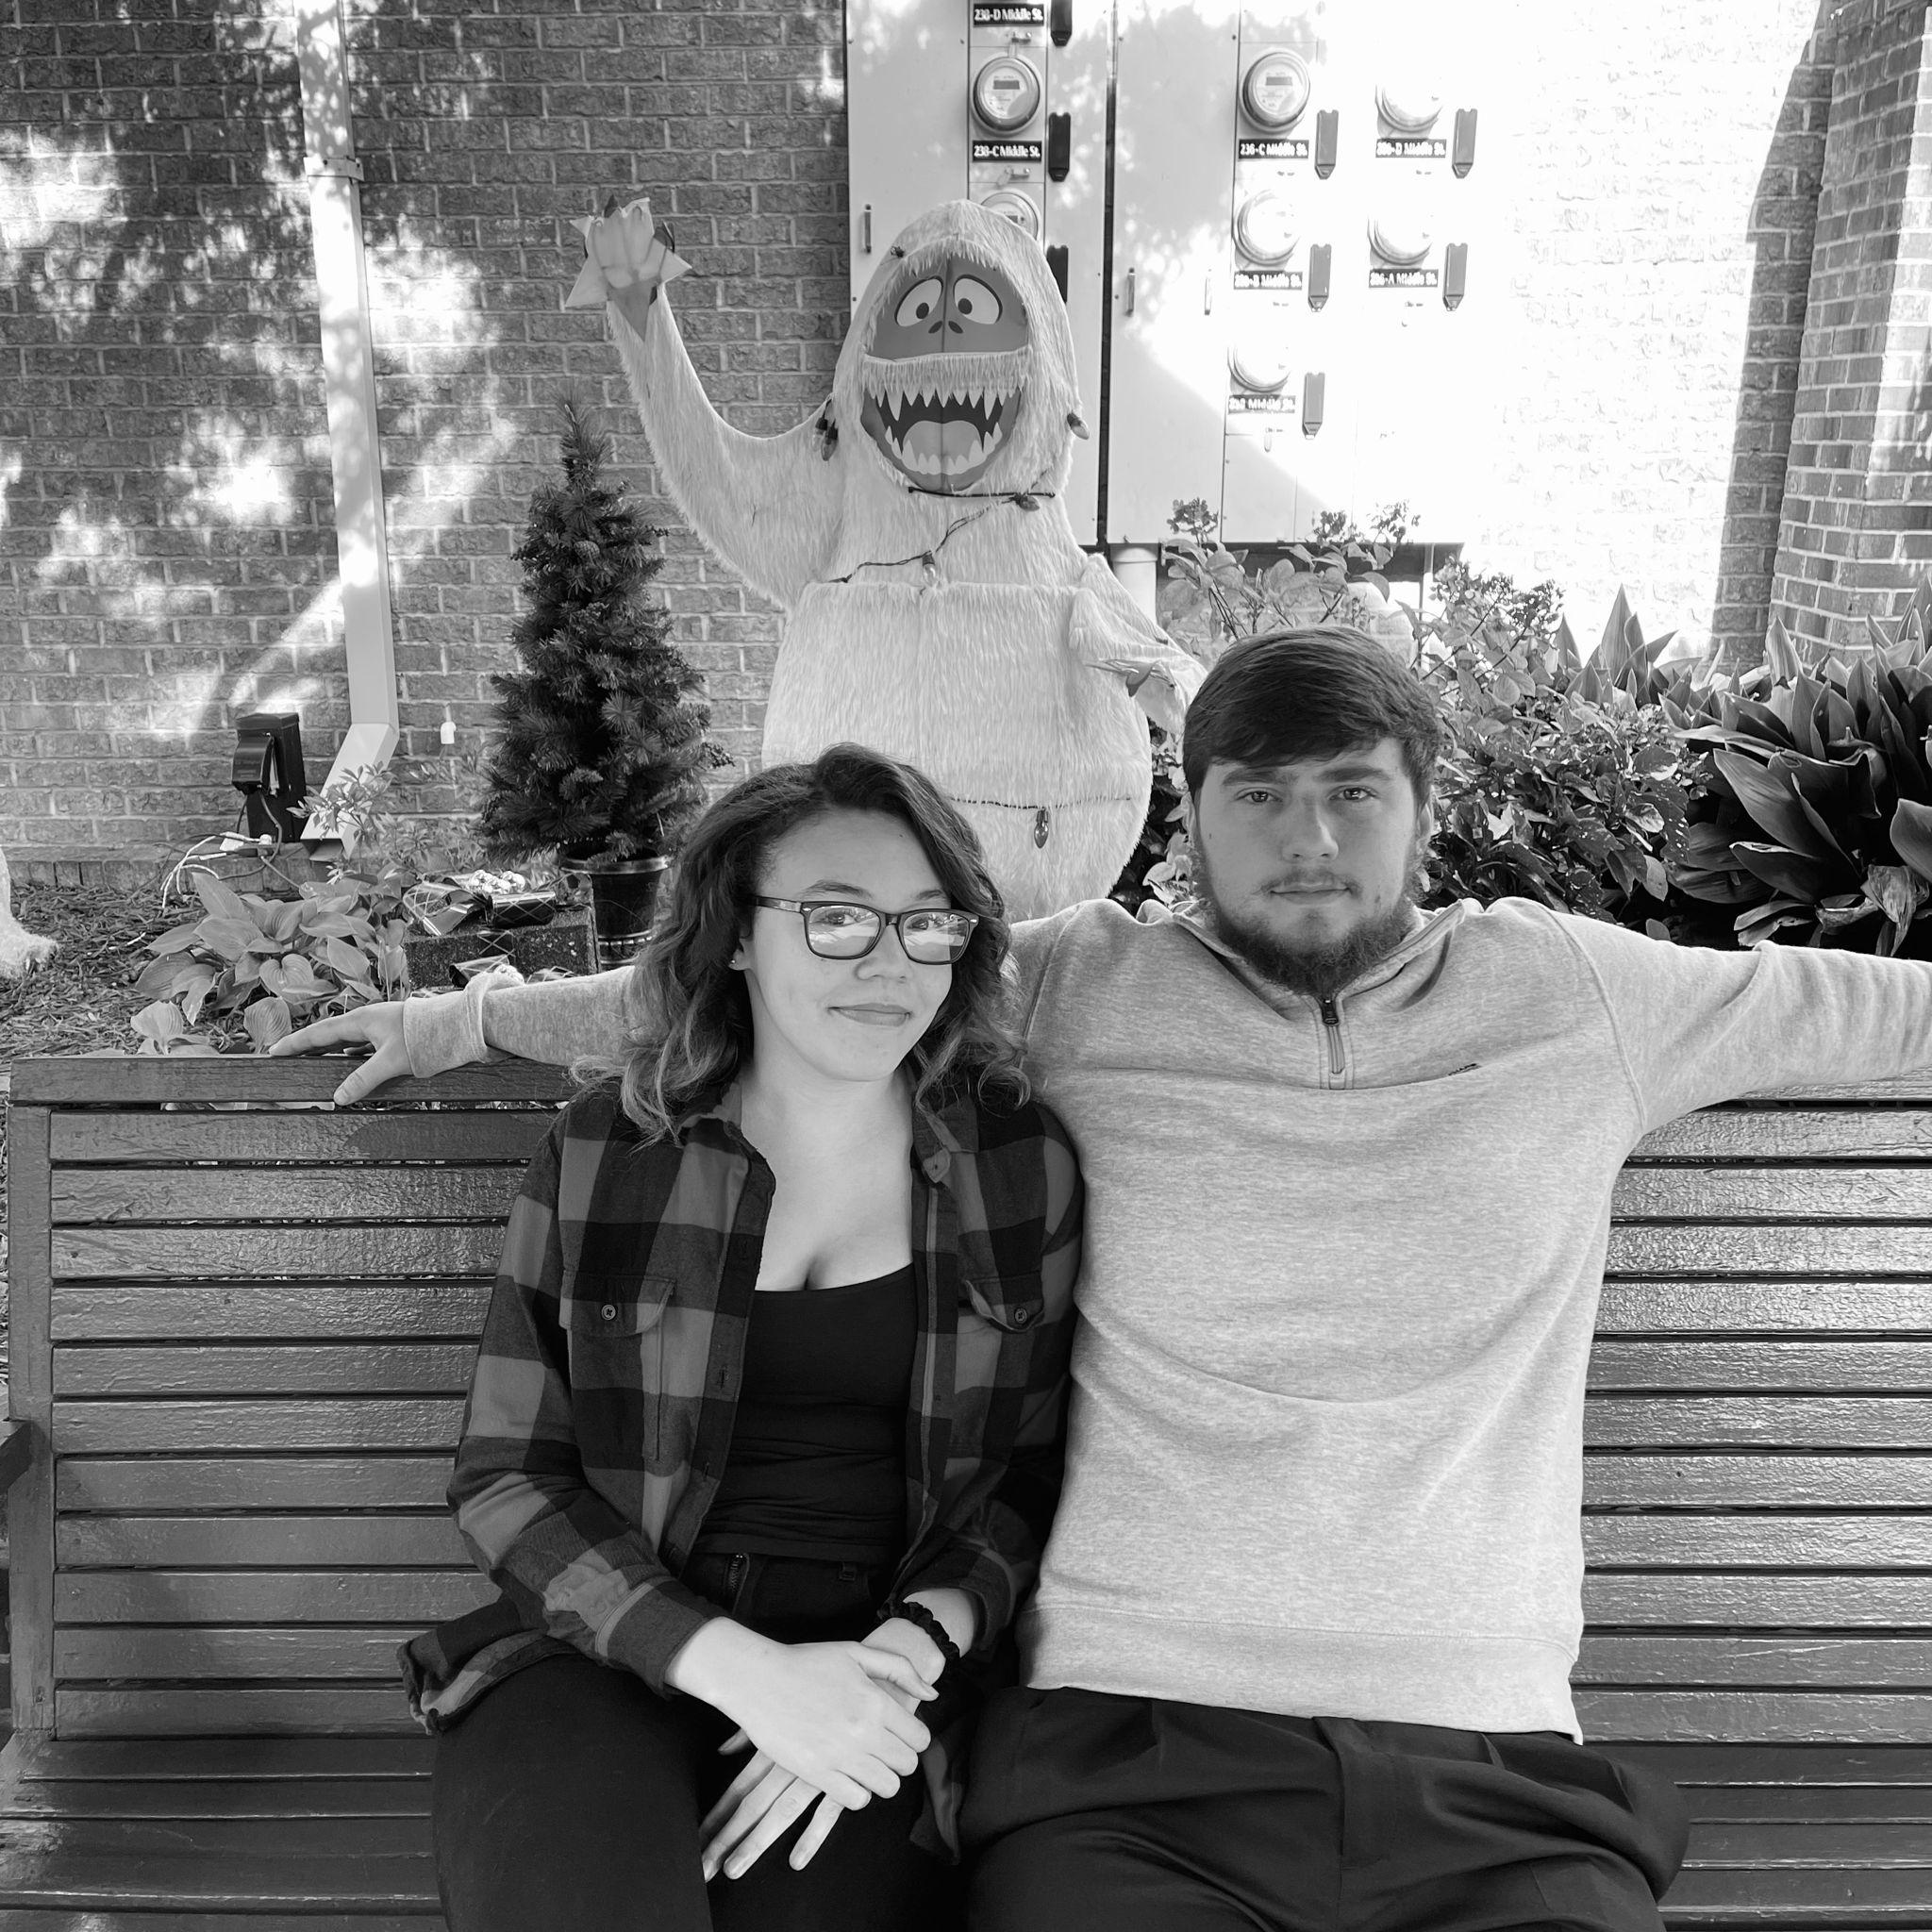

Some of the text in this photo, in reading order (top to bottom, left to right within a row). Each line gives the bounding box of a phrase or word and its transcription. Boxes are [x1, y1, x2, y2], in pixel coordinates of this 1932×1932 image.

[974, 8, 1043, 21] 238-D Middle St.
[974, 144, 1041, 158] 238-C Middle St.
[1240, 142, 1307, 156] 236-C Middle St.
[1404, 142, 1433, 156] Middle
[1396, 272, 1424, 286] Middle
[1248, 398, 1281, 410] Middle
